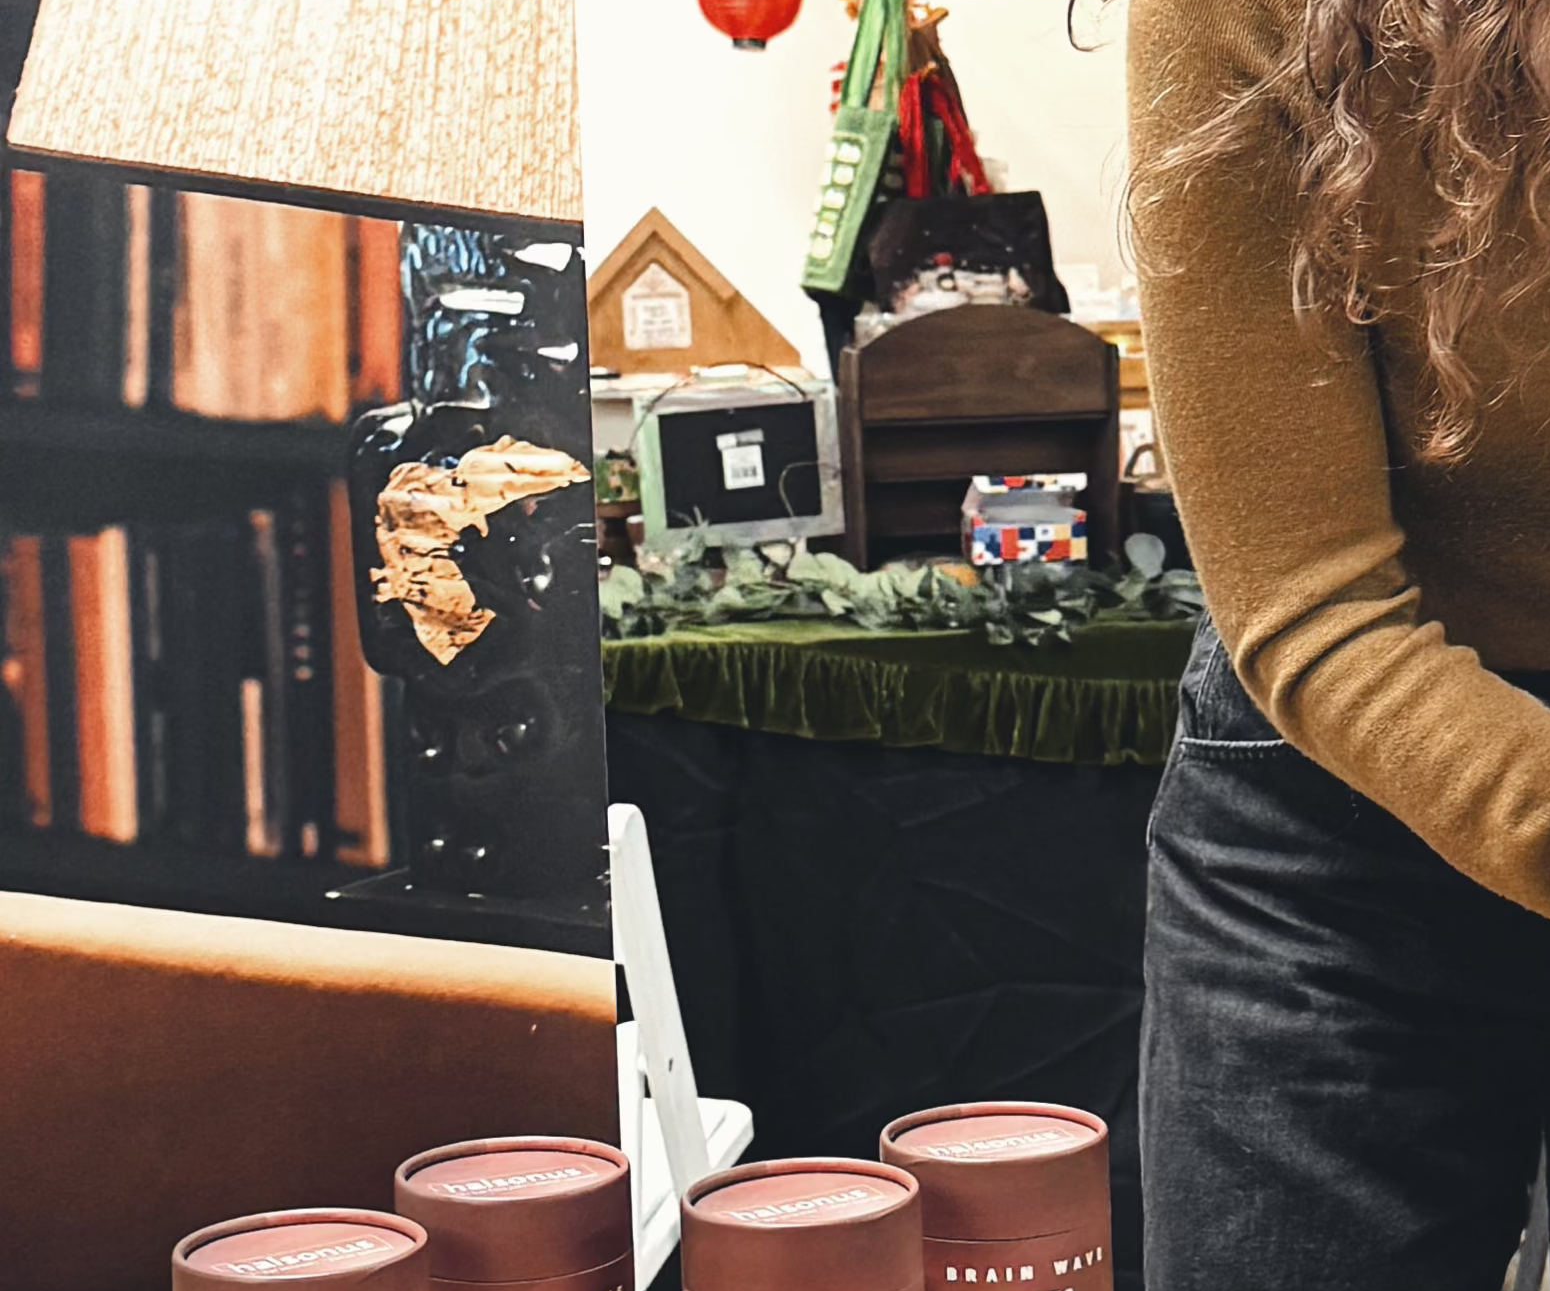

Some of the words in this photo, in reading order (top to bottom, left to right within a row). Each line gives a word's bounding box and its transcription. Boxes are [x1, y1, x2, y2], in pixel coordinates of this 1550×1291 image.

[442, 1165, 583, 1194] halsonus
[730, 1188, 868, 1222] halsonus
[227, 1239, 375, 1274] halsonus
[946, 1265, 1034, 1284] BRAIN
